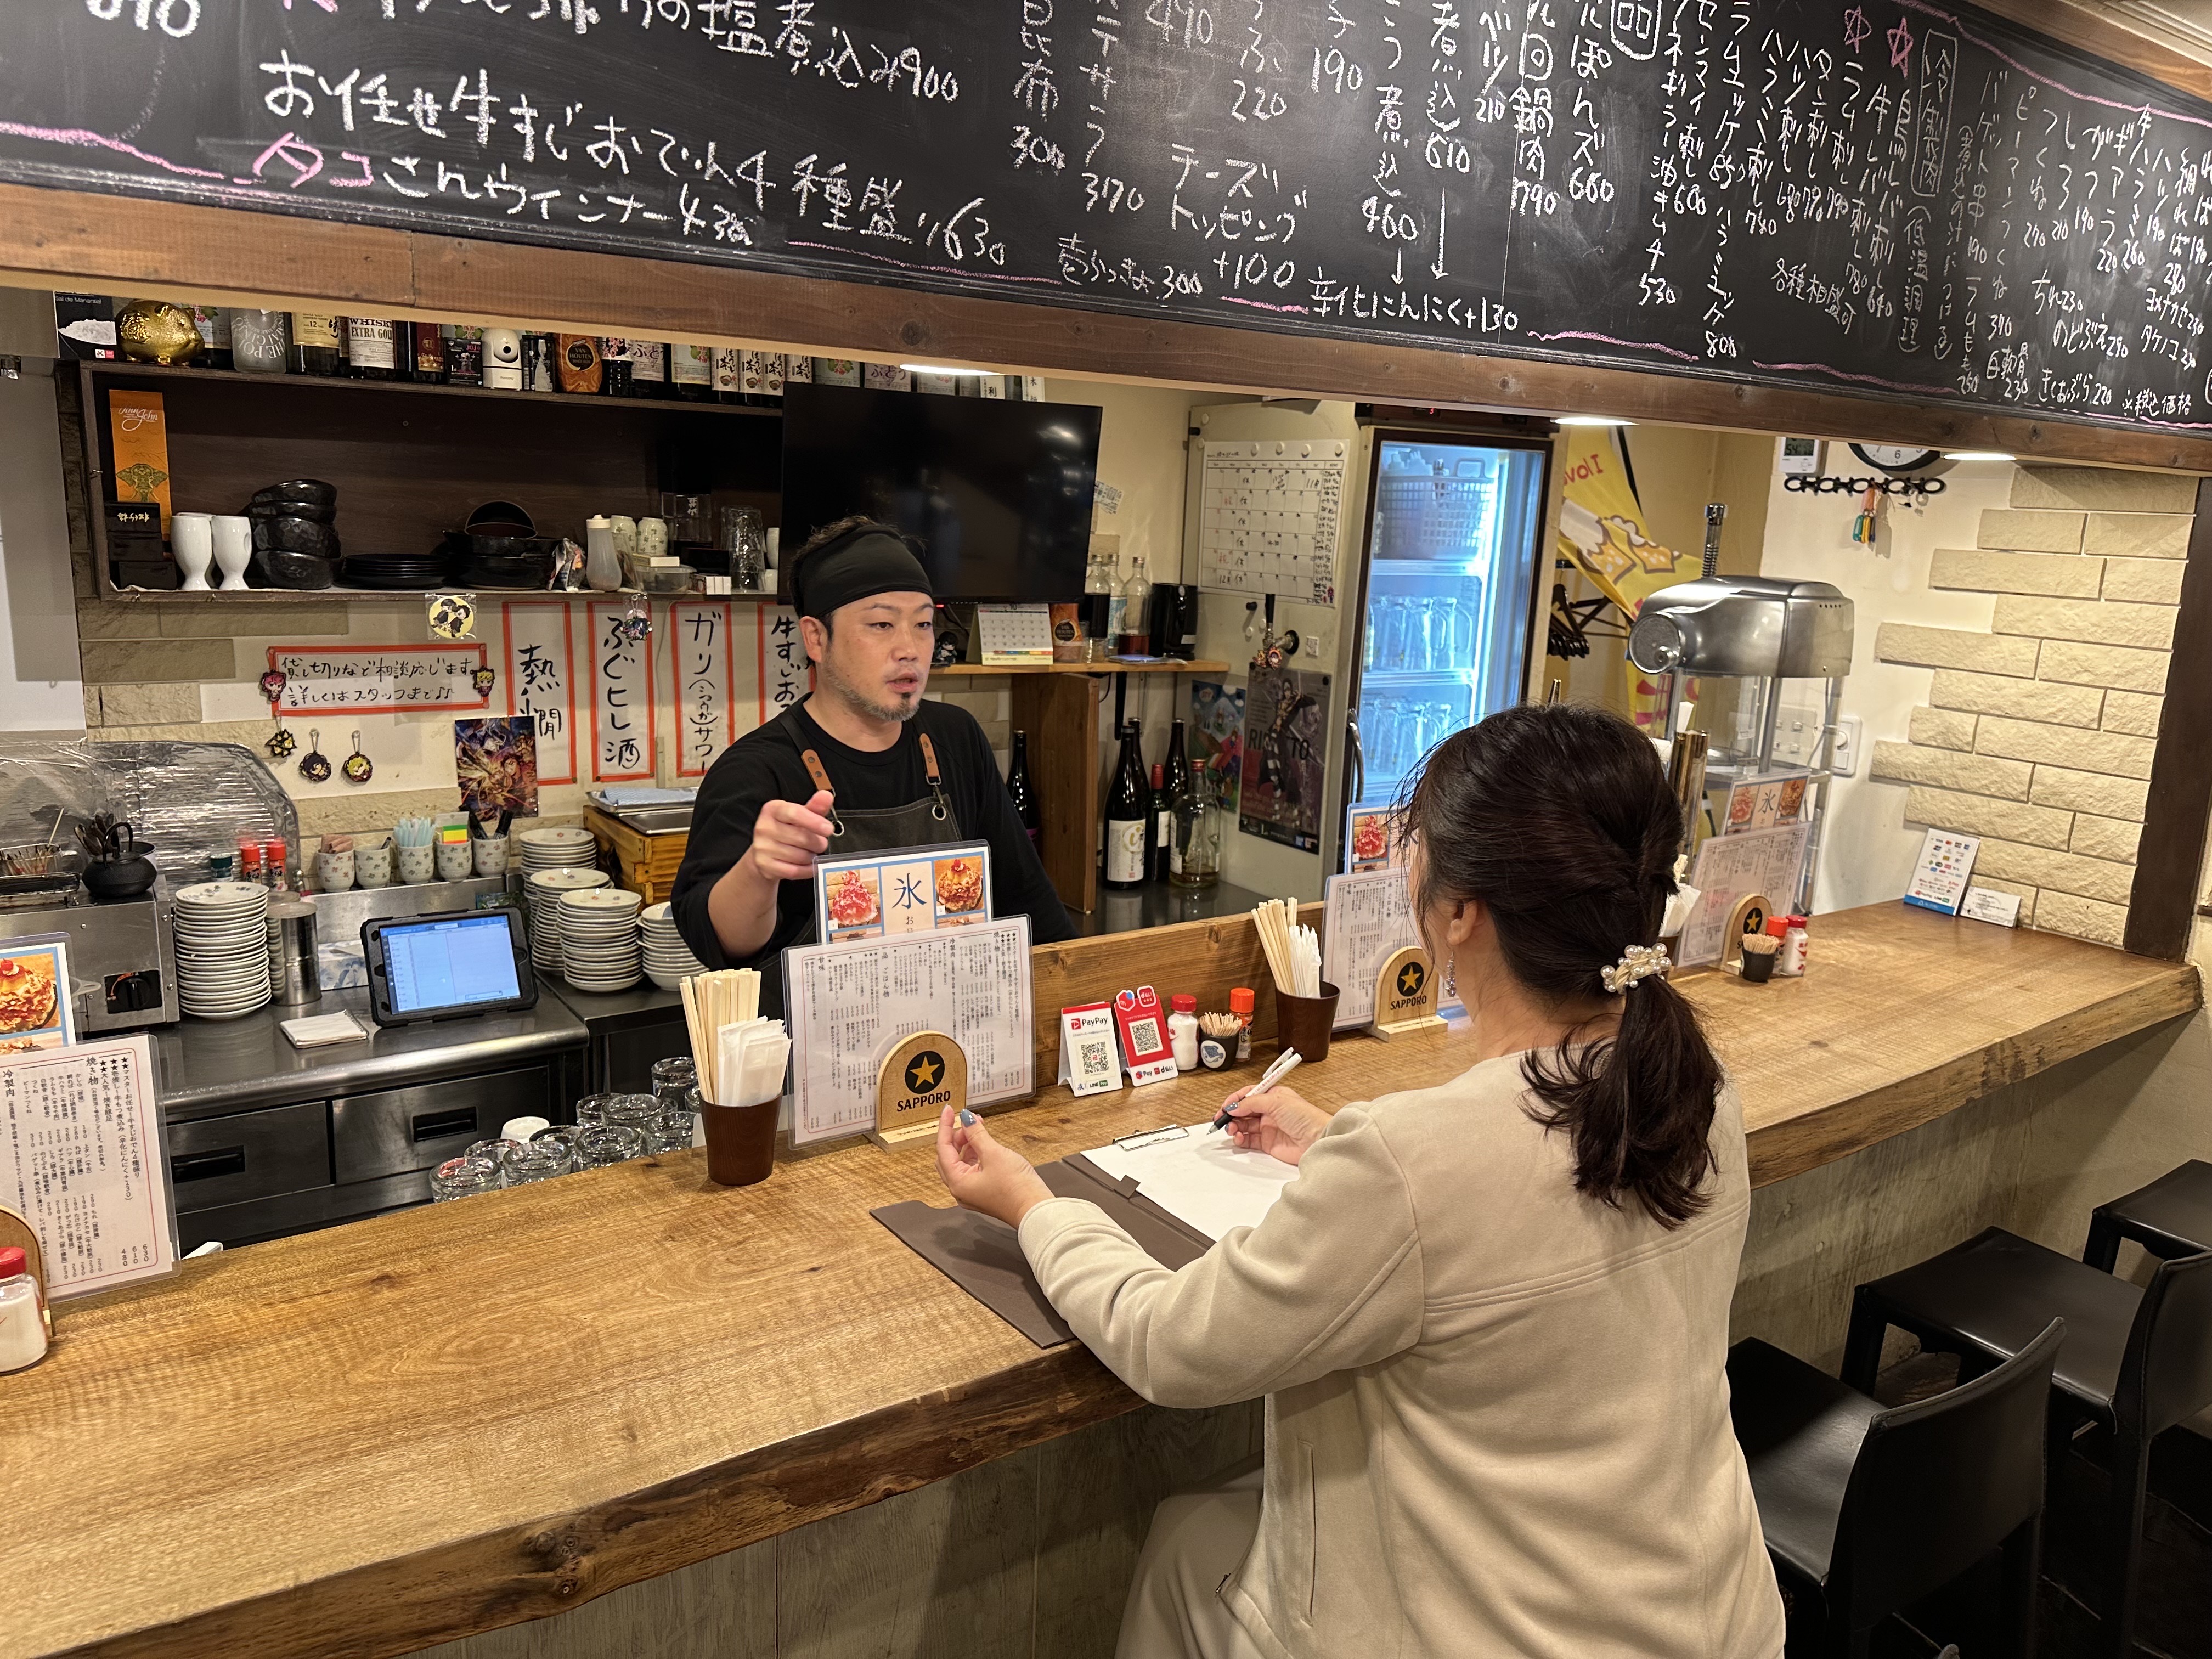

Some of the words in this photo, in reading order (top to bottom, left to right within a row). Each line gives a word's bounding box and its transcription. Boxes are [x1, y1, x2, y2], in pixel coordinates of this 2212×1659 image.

[1311, 46, 1363, 93] 190
[1231, 79, 1287, 122] 220
[1474, 97, 1505, 123] 210
[1425, 132, 1470, 173] 610
[1172, 143, 1279, 199] チーズ
[1081, 172, 1146, 213] 370
[1213, 251, 1295, 290] +100
[1639, 273, 1677, 306] 530
[351, 326, 375, 337] EXTRA
[2004, 377, 2029, 402] 230
[1894, 449, 1901, 459] 6
[771, 615, 802, 709] 牛すじお
[1758, 789, 1776, 814] 氷
[891, 872, 928, 910] 氷
[817, 956, 826, 972] 甘味
[1390, 995, 1427, 1011] SAPPORO
[1081, 1017, 1108, 1027] PayPay
[2, 1069, 15, 1098] 冷製肉
[86, 1056, 99, 1086] 焼き物
[896, 1090, 951, 1113] SAPPORO
